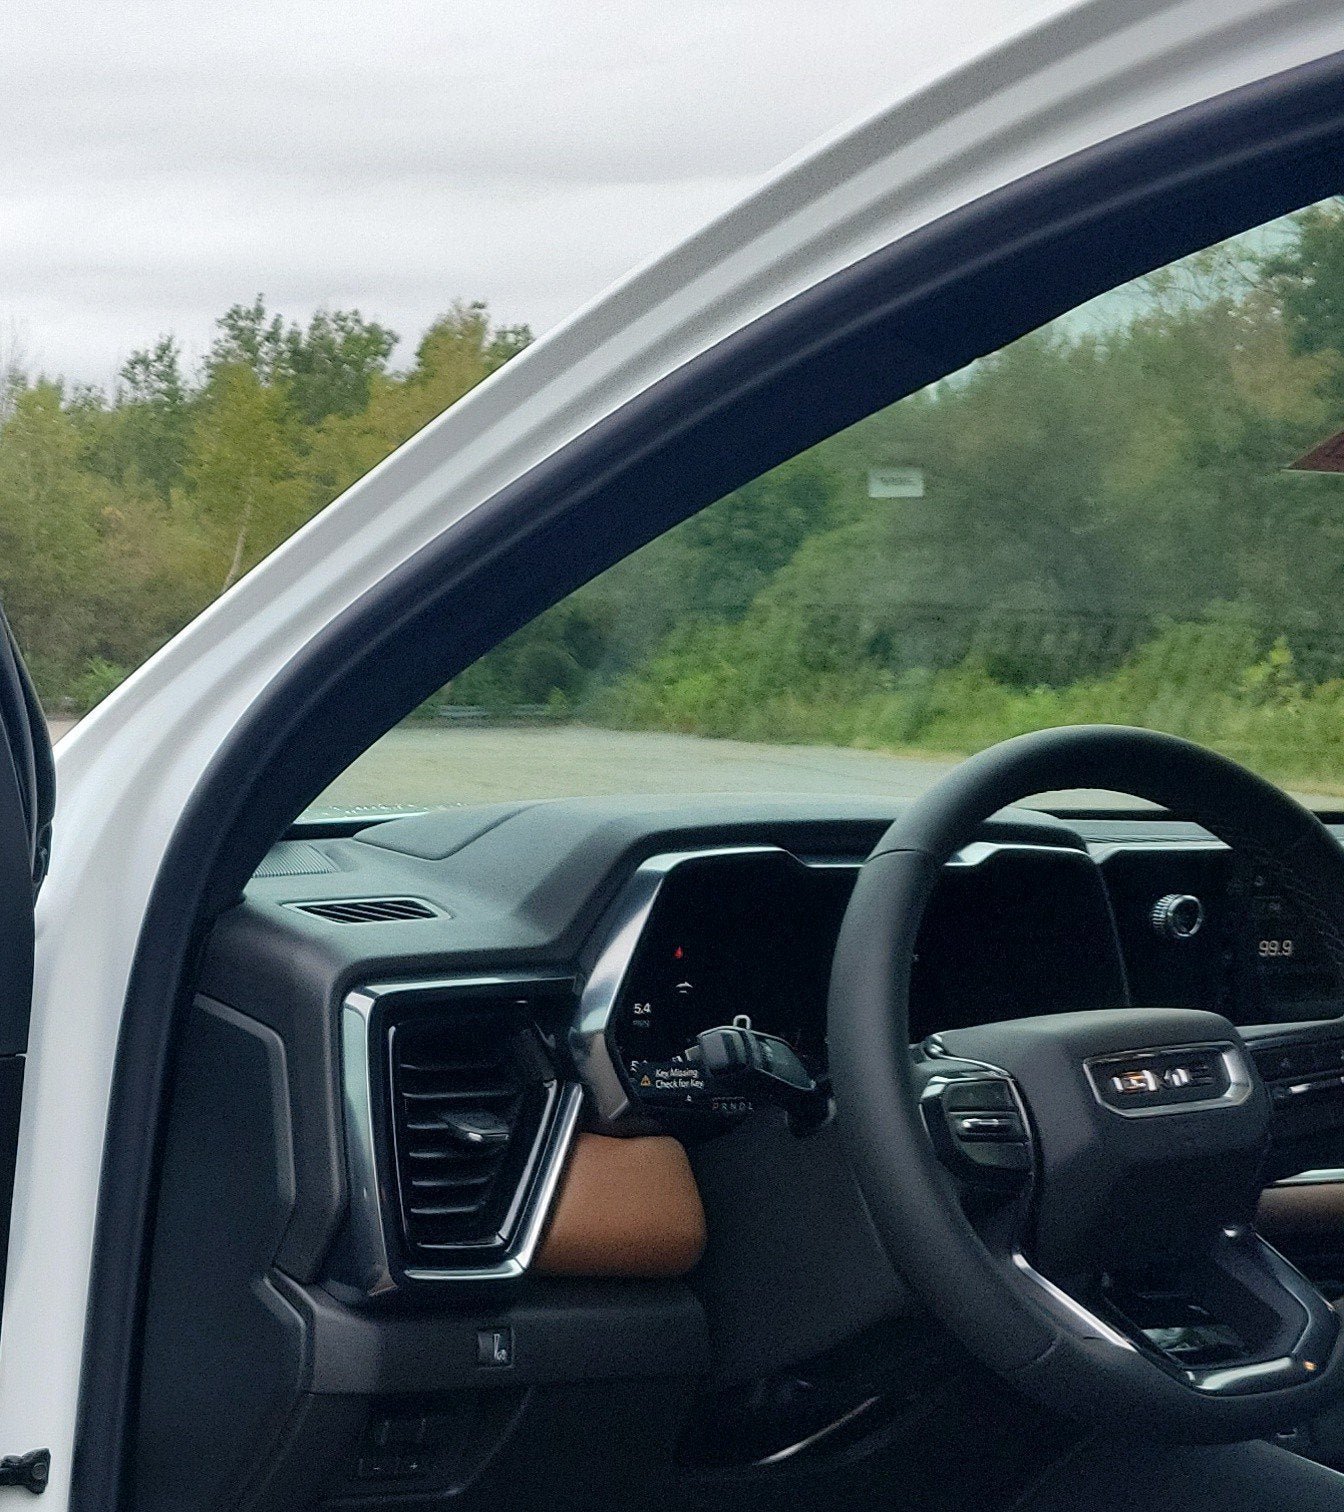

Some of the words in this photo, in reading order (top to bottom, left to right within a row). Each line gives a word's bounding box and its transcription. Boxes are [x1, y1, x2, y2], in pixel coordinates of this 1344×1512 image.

[655, 1068, 669, 1079] Key
[670, 1067, 699, 1079] Missing
[655, 1079, 678, 1089] Check
[690, 1079, 704, 1090] Key
